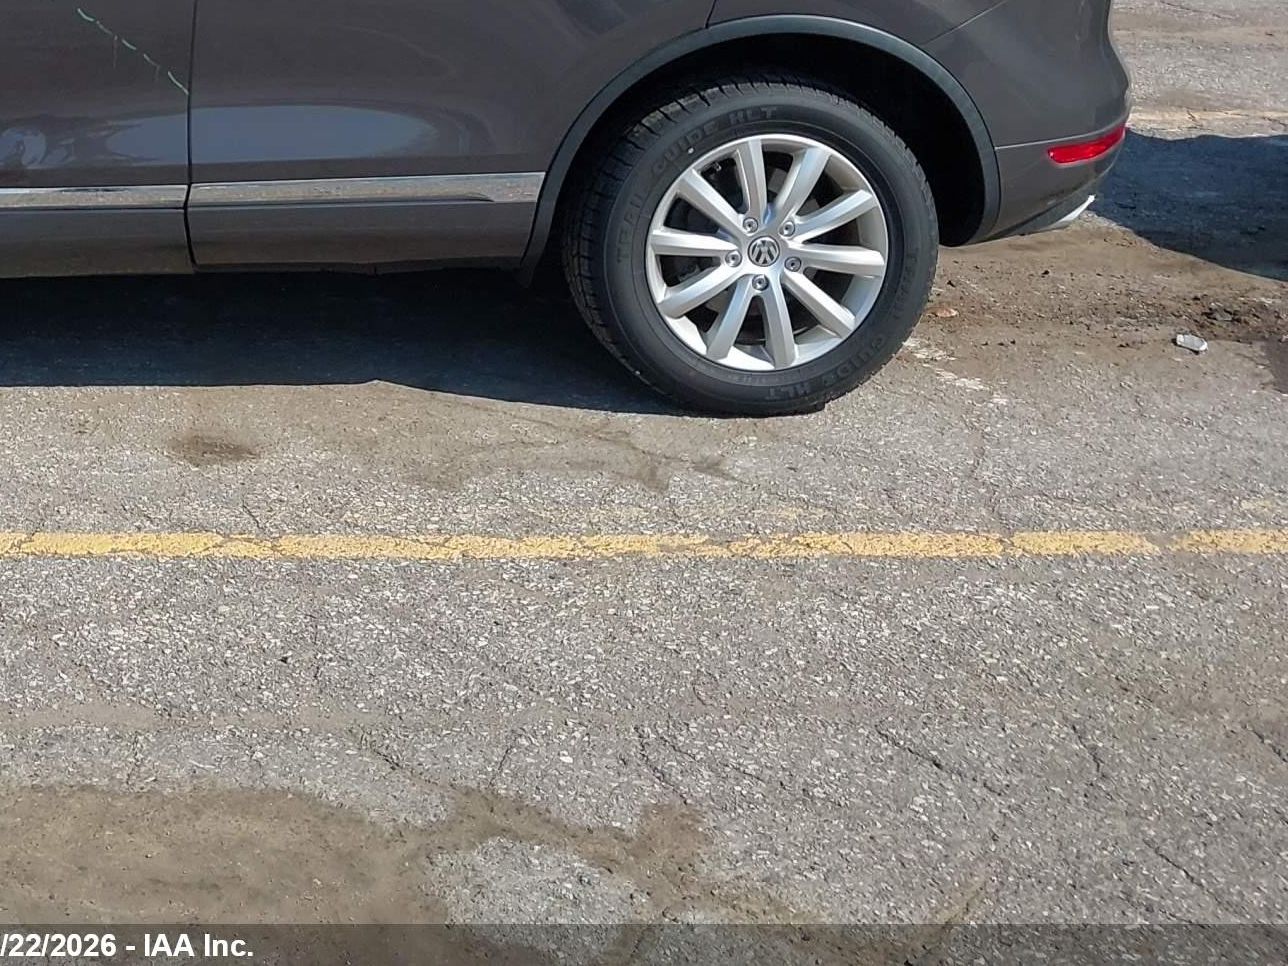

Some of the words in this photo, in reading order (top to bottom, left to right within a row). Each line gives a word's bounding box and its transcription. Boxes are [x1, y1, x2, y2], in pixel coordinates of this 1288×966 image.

[615, 192, 645, 265] TRAIL
[651, 119, 720, 177] GUIDE
[728, 105, 778, 125] HLT
